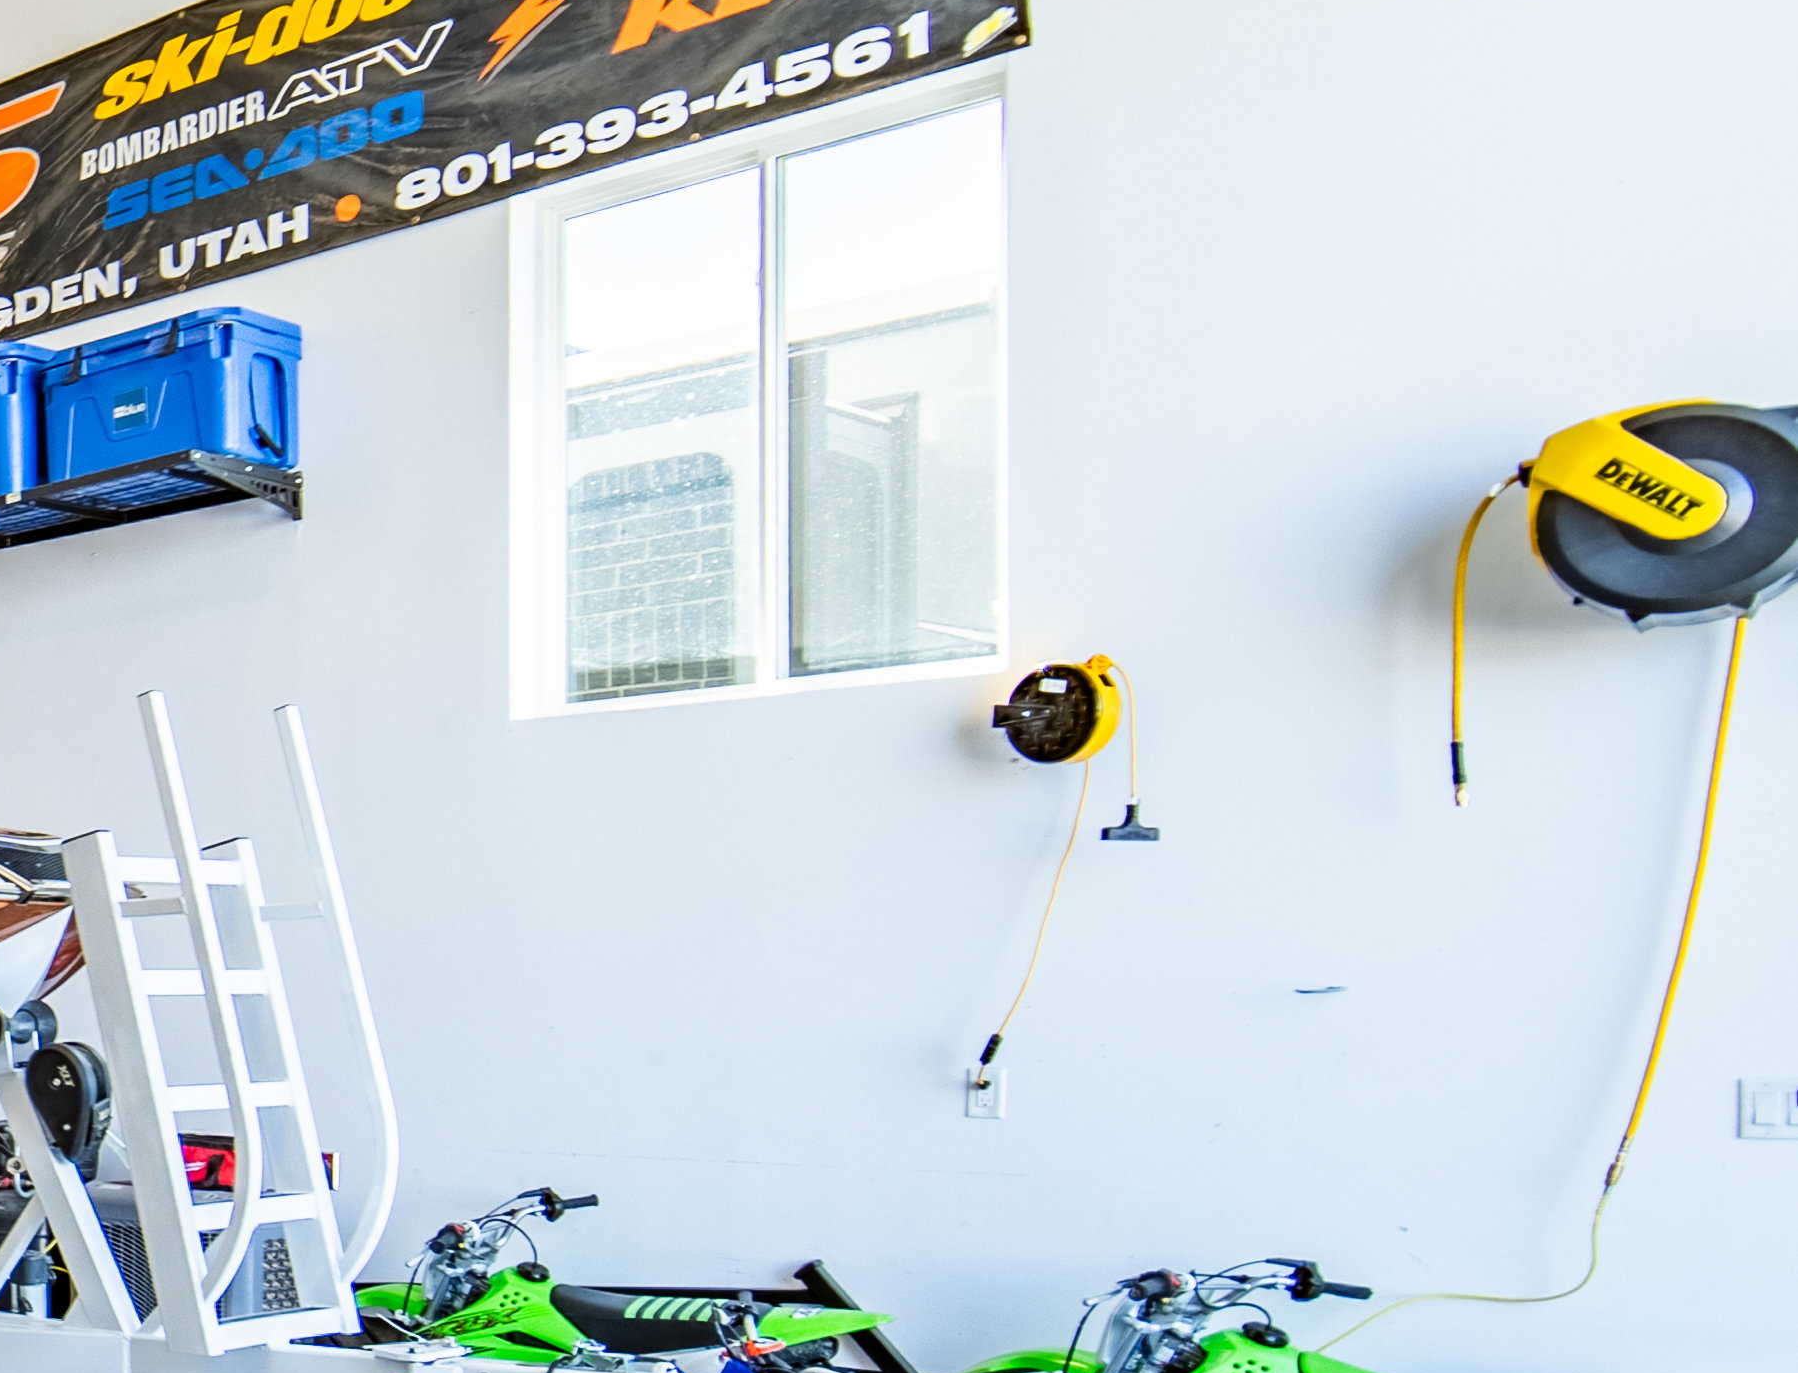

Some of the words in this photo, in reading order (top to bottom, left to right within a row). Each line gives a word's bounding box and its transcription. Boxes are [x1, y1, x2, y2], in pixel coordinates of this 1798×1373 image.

[79, 89, 267, 183] BOMBARDIER
[268, 18, 454, 122] ATV
[158, 202, 310, 281] UTAH
[395, 9, 934, 212] 801-393-4561
